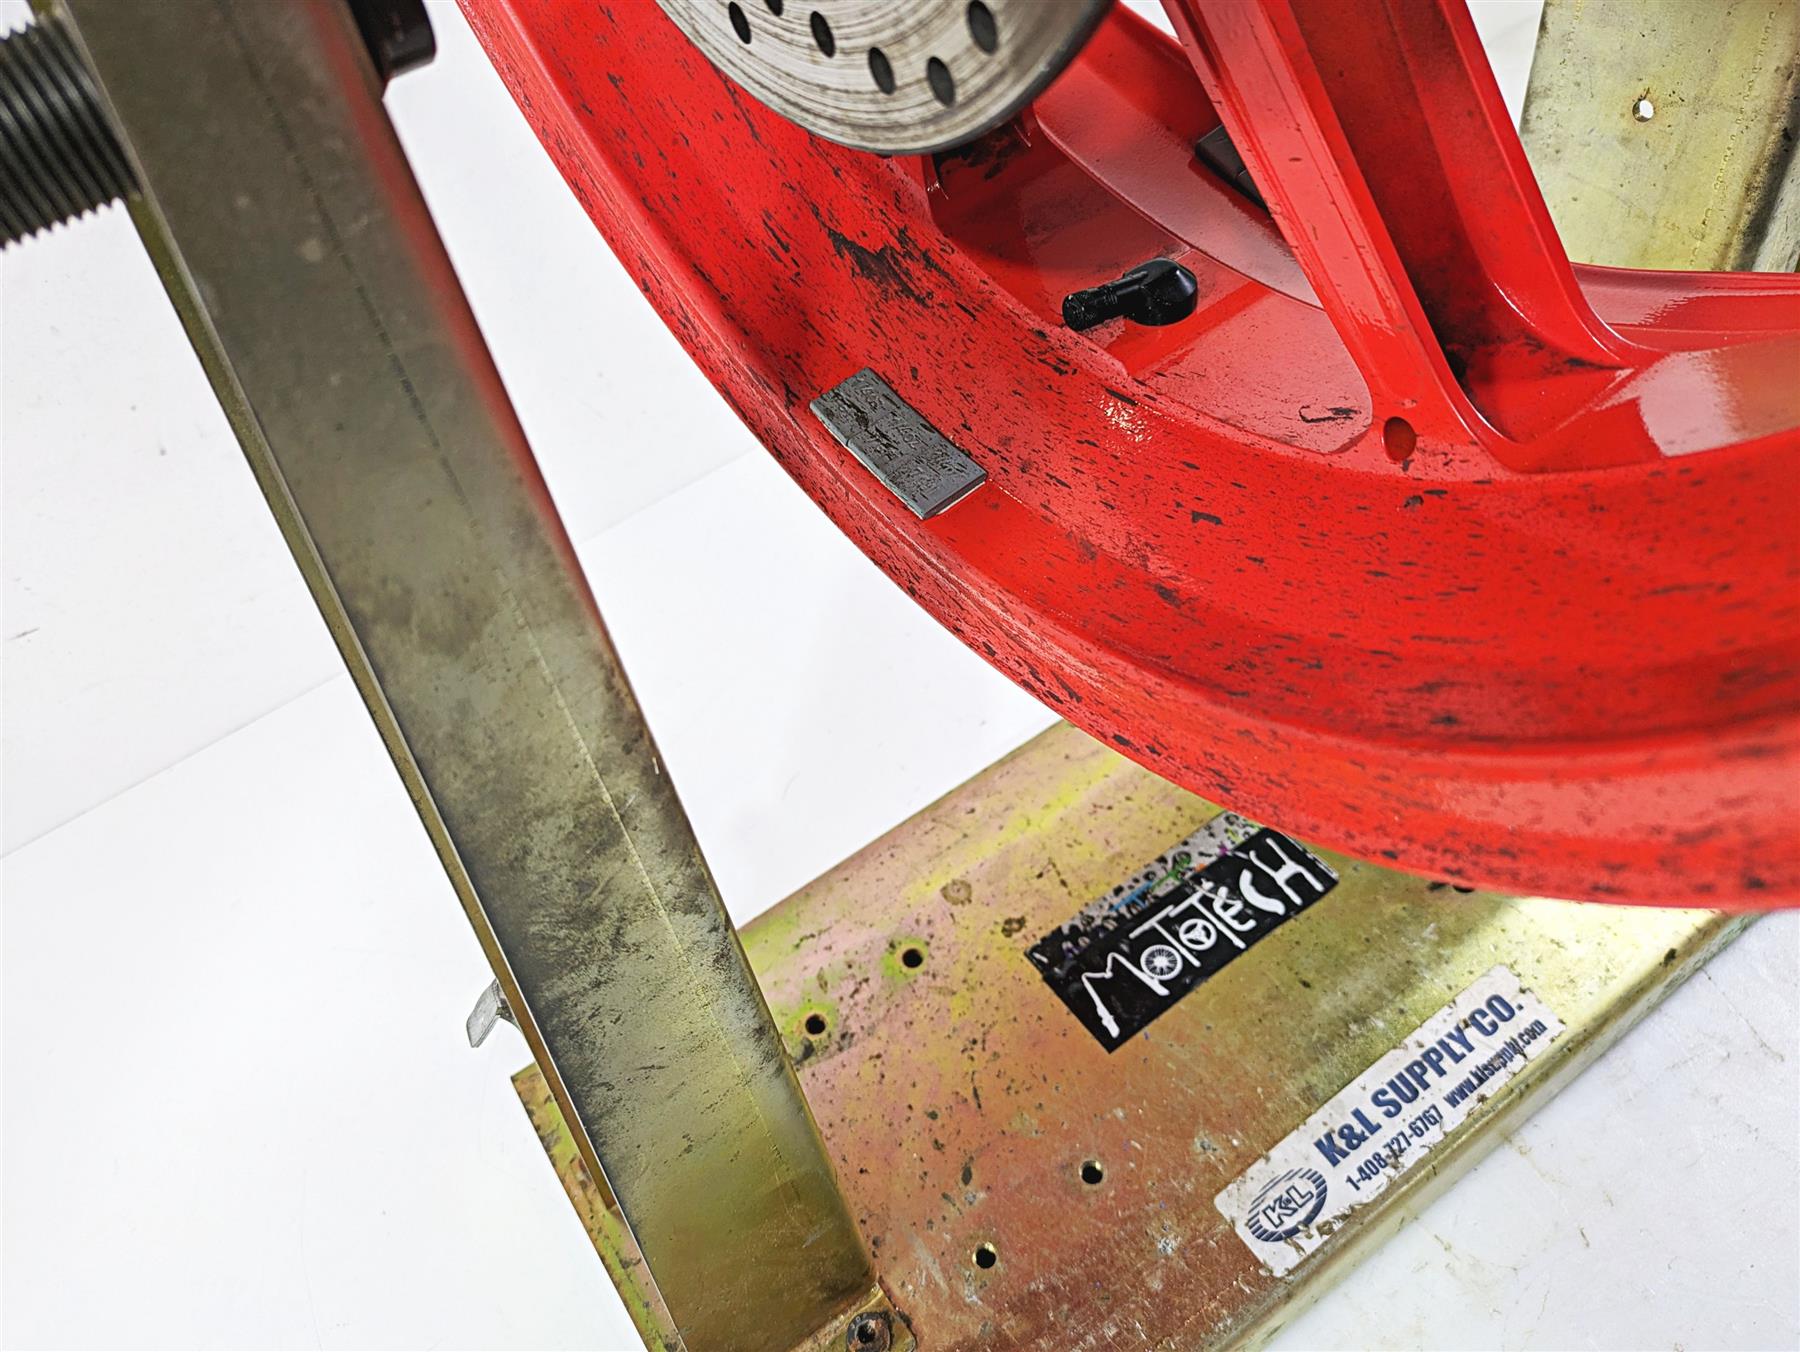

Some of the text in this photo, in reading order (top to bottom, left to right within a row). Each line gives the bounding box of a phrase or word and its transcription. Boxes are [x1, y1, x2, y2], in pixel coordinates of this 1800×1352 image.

[1313, 993, 1525, 1168] K&L SUPPLY CO.
[1345, 1018, 1548, 1192] 1-408-727-6767 www.klsupply.com
